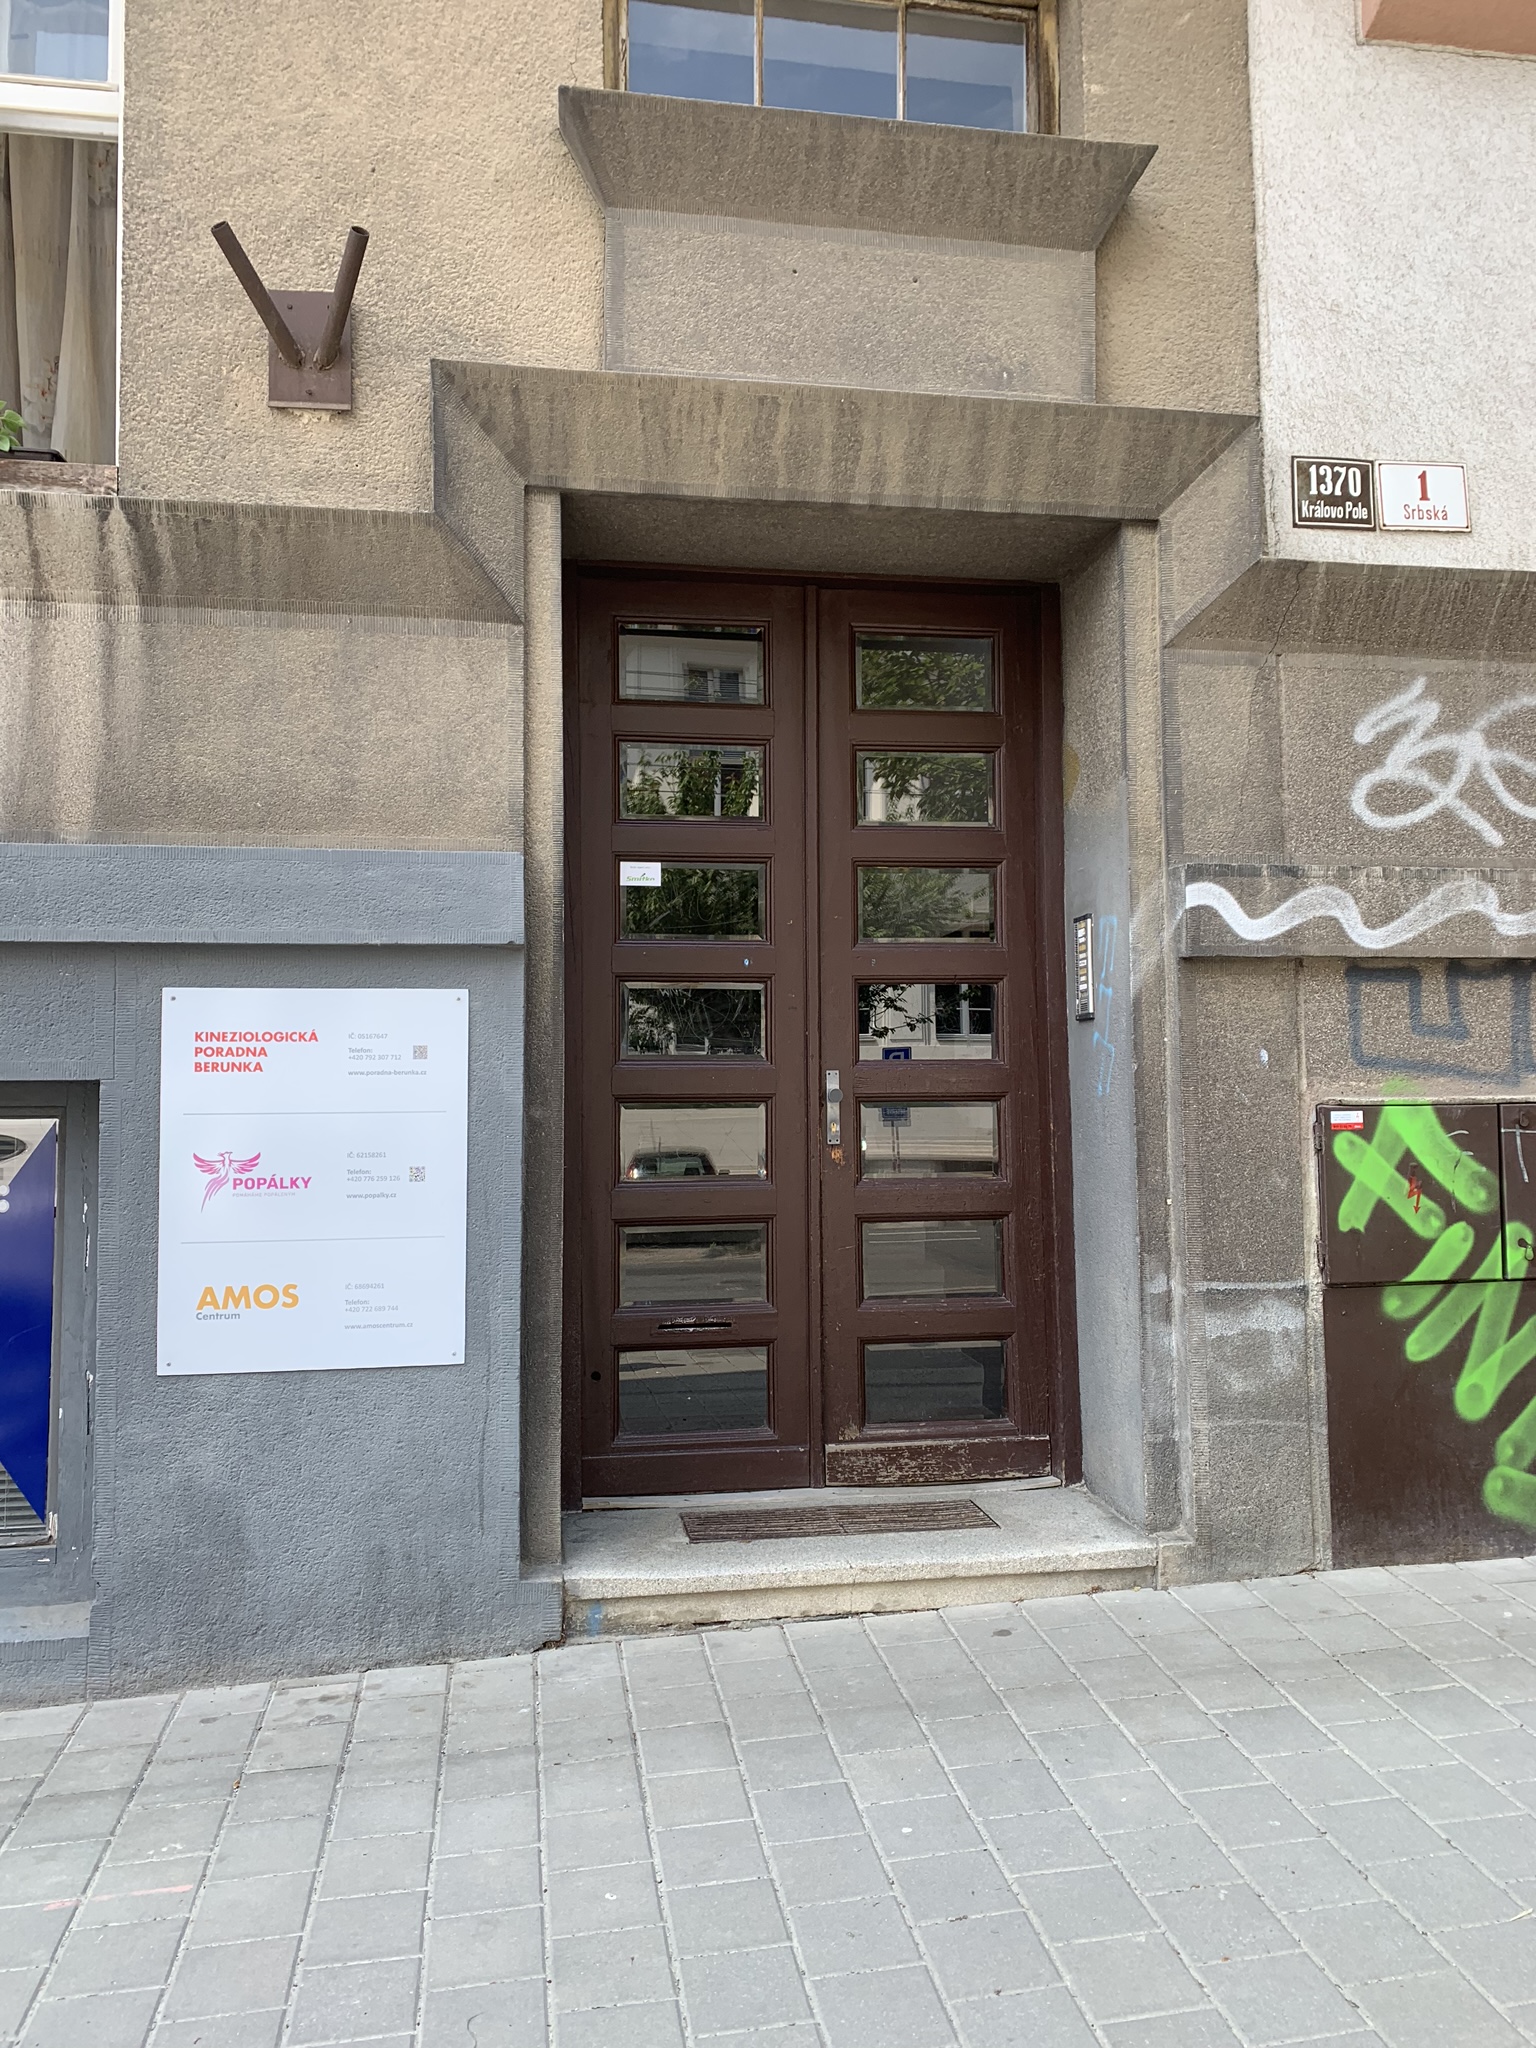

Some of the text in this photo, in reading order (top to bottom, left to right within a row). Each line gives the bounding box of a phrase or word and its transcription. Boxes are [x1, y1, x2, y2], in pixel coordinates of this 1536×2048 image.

[1309, 464, 1361, 497] 1370
[1417, 470, 1430, 501] 1
[1301, 499, 1368, 519] Královo Pole
[1403, 503, 1448, 521] Srbská
[194, 1029, 318, 1043] KINEZIOLOGICKÁ
[194, 1047, 268, 1058] PORADNA
[194, 1062, 263, 1072] BERUNKA
[347, 1069, 427, 1077] www.poradna-berunka.cz
[232, 1175, 312, 1190] POPÁLKY
[346, 1192, 397, 1200] www.popalky.cz
[196, 1284, 300, 1310] AMOS
[195, 1311, 241, 1321] Centrum
[344, 1322, 414, 1330] www.amoscentrum.cz
